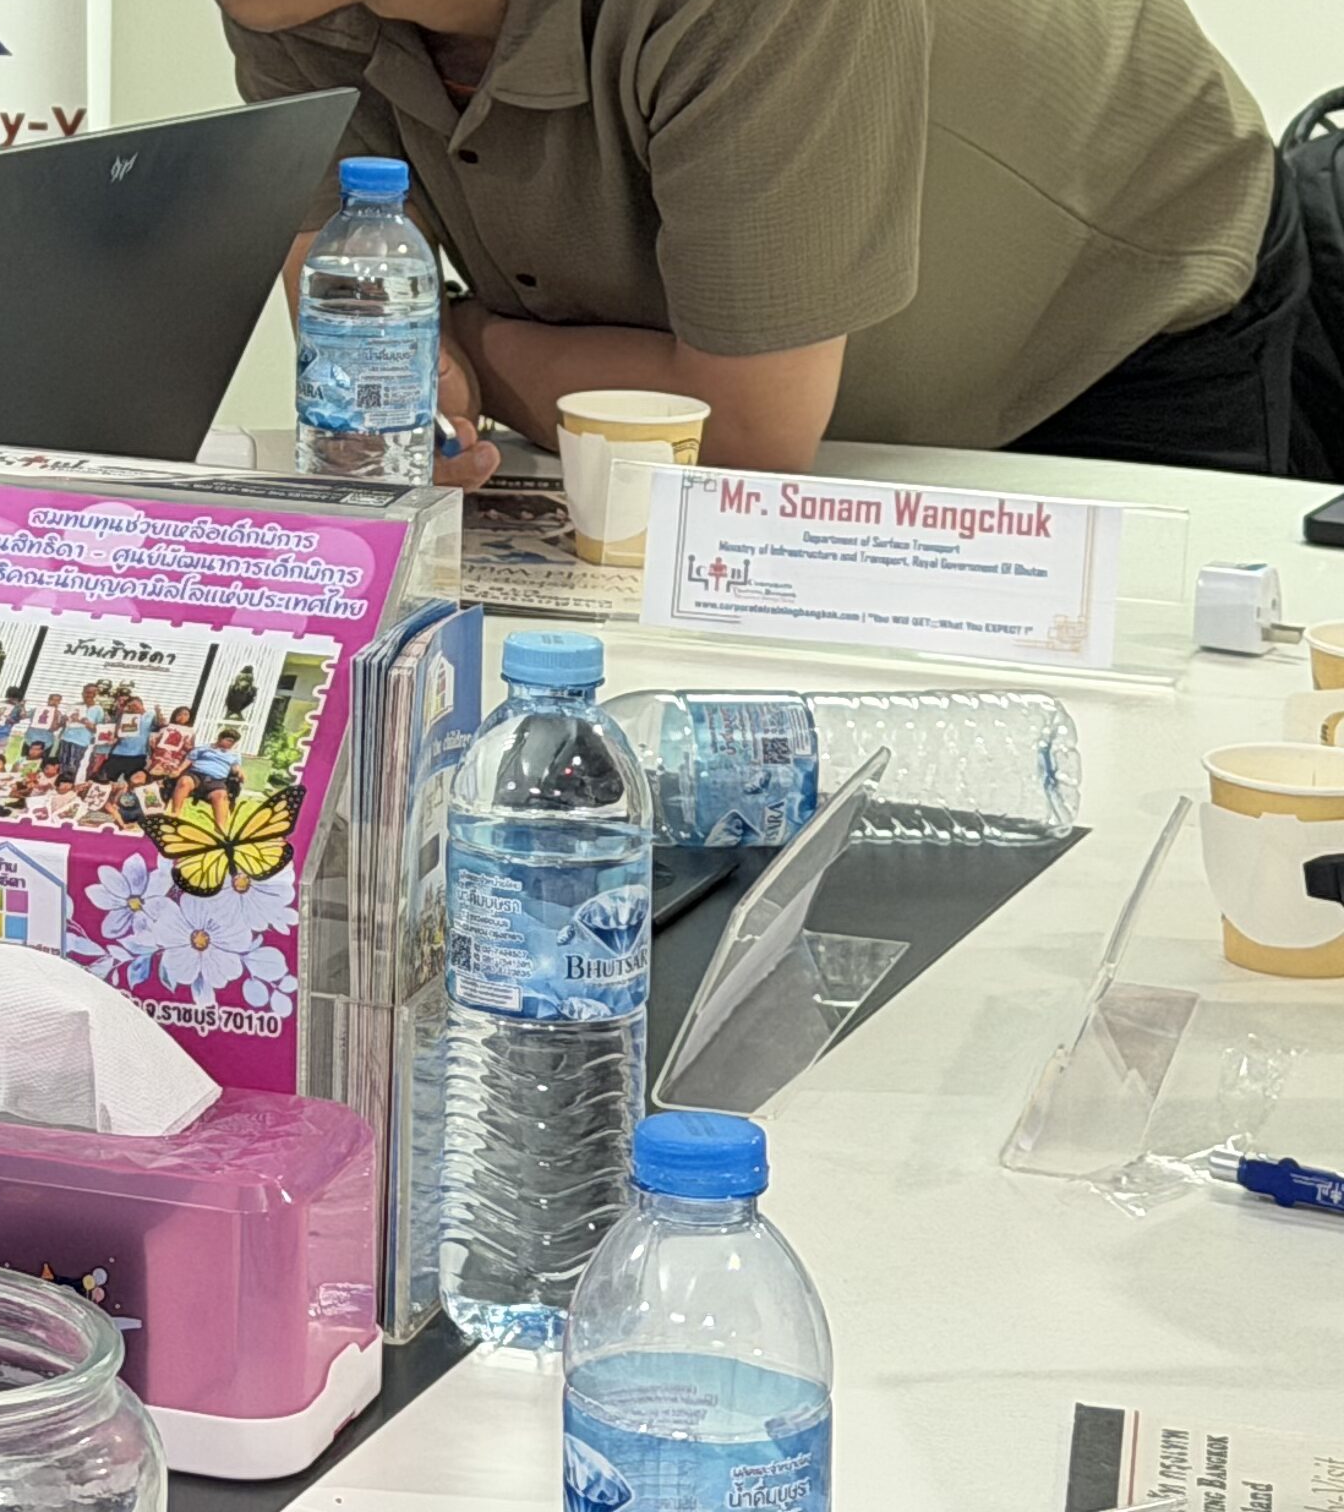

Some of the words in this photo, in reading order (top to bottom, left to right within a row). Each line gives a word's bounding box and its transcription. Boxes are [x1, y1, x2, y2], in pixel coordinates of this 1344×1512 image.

[719, 477, 768, 517] Mr.
[779, 483, 882, 525] Sonam
[894, 489, 1052, 540] Wangchuk
[802, 530, 859, 550] Department
[913, 537, 960, 555] Transport
[221, 1010, 280, 1035] 70110
[1196, 1434, 1230, 1491] BANGKOK
